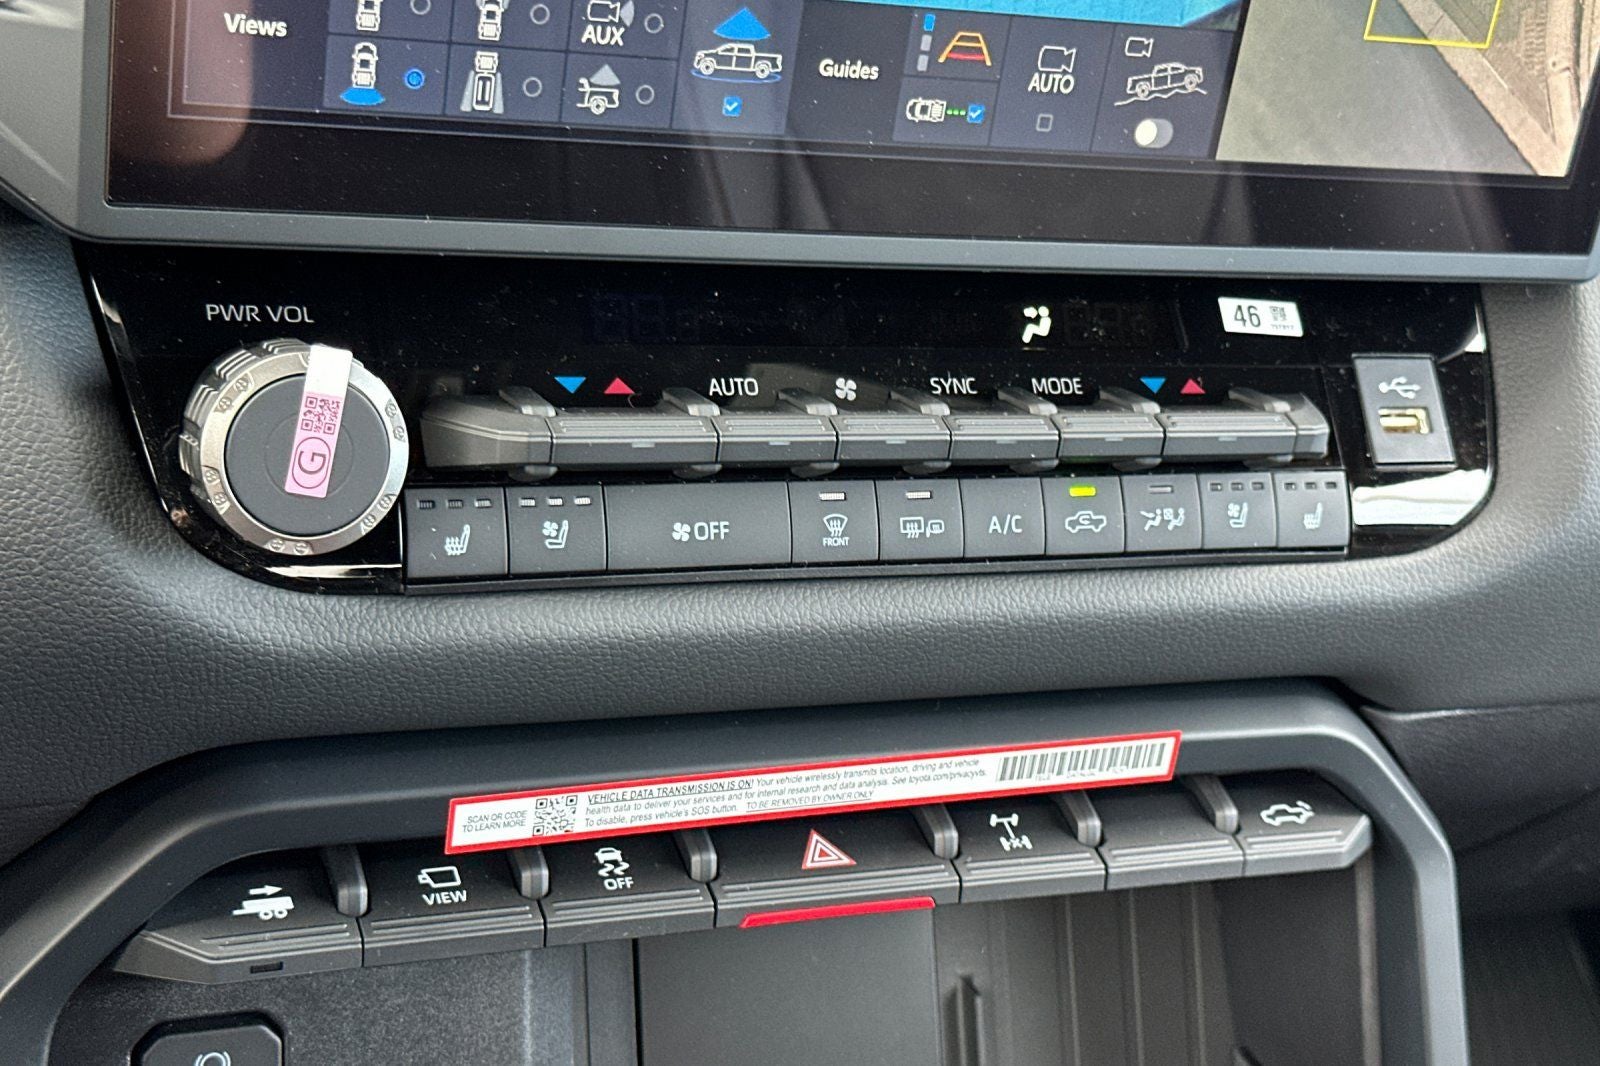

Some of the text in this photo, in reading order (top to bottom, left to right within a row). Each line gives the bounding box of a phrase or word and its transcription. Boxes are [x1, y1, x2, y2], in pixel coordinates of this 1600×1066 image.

[223, 12, 287, 37] Views
[581, 24, 625, 46] AUX
[819, 58, 879, 80] Guides
[1028, 72, 1075, 94] AUTO
[205, 304, 315, 323] PWR VOL
[1233, 304, 1261, 328] 46
[709, 377, 759, 396] AUTO
[929, 377, 978, 395] SYNC
[1031, 377, 1084, 395] MODE
[297, 450, 327, 475] G
[694, 521, 730, 541] OFF
[988, 514, 1023, 535] A/C
[822, 536, 850, 547] FRONT
[588, 758, 980, 804] VEHICLE DATA TRANSMISSION IS ON! Your vehicle wirelessly transmits location, driving and vehicle
[586, 805, 612, 816] health
[613, 803, 631, 812] data
[634, 802, 642, 811] to
[644, 800, 672, 810] deliver
[674, 799, 691, 809] your
[693, 794, 726, 805] services
[728, 792, 743, 802] and
[745, 789, 757, 800] for
[757, 788, 786, 798] internal
[787, 784, 821, 796] research
[823, 782, 838, 792] and
[839, 780, 856, 790] data
[857, 778, 888, 790] analysis.
[892, 776, 907, 786] See
[467, 813, 490, 823] SCAN
[504, 810, 528, 819] CODE
[585, 817, 595, 828] To
[596, 814, 628, 827] disable,
[630, 812, 653, 823] press
[655, 809, 689, 820] vehicle's
[691, 806, 710, 817] SOS
[747, 801, 758, 810] TO
[759, 799, 769, 809] BE
[771, 796, 811, 807] REMOVED
[812, 794, 822, 804] BY
[823, 792, 851, 803] OWNER
[853, 790, 875, 800] ONLY
[463, 819, 527, 832] TO LEARN MORE
[604, 876, 634, 891] OFF
[422, 890, 467, 906] VIEW
